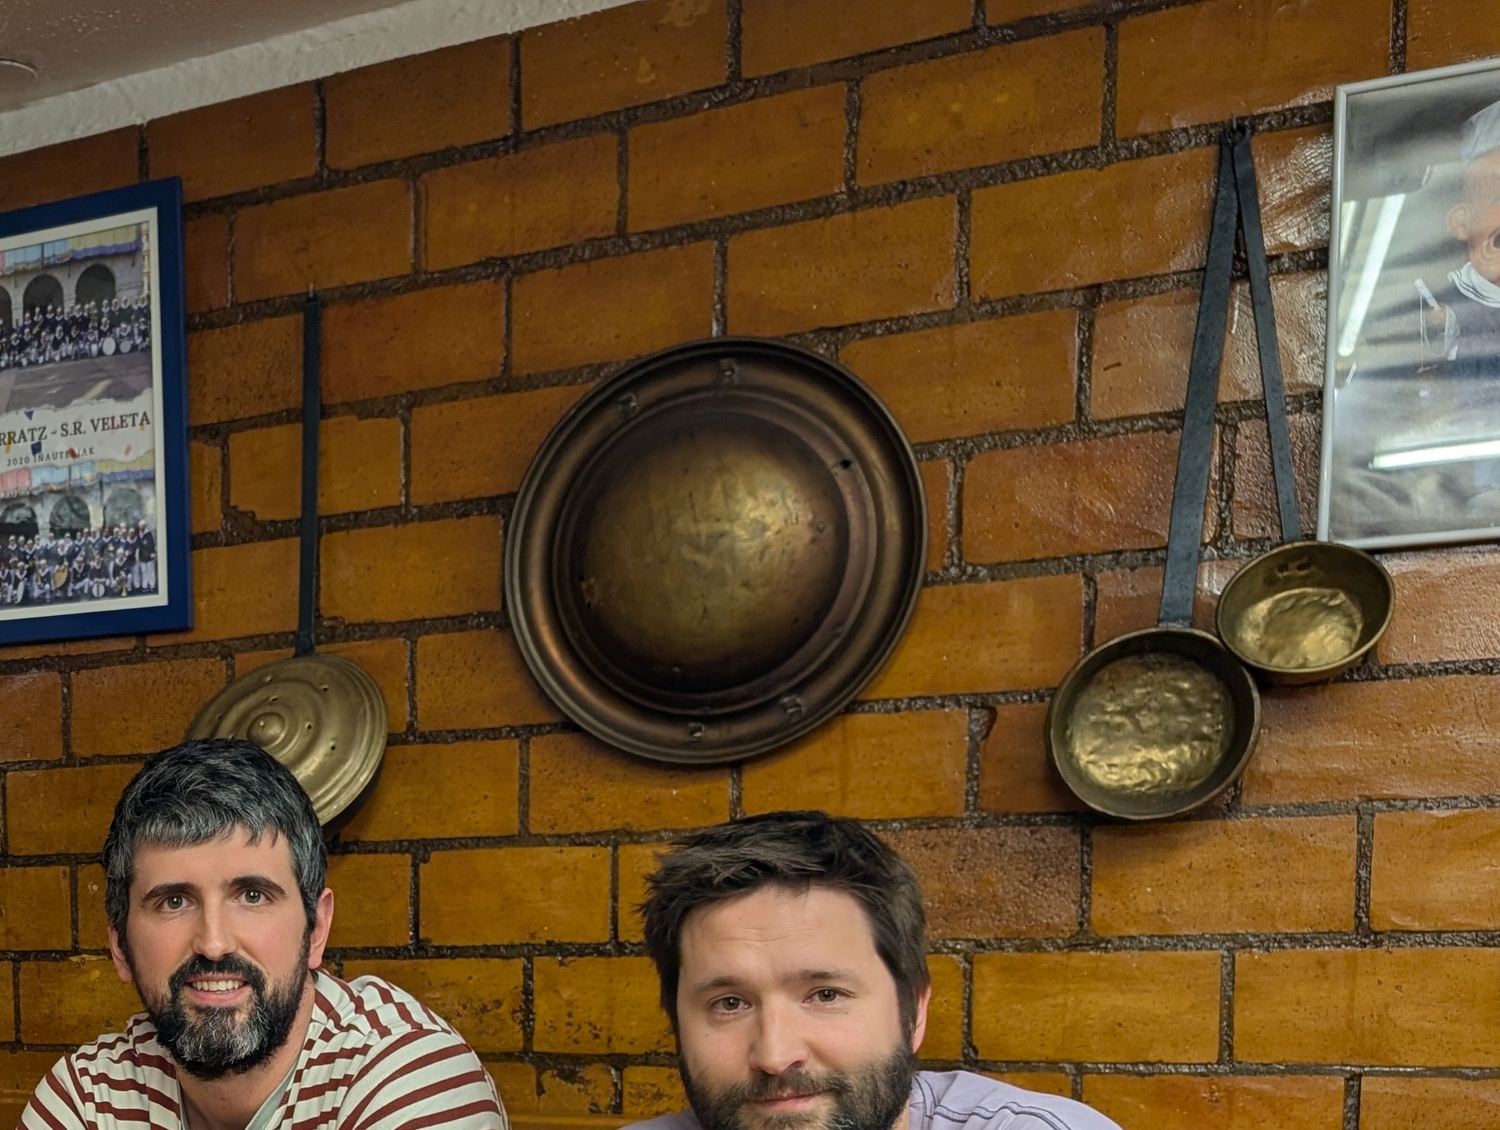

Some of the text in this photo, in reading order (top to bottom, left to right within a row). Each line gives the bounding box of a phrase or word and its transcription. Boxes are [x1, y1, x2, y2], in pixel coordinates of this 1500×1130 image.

[59, 421, 87, 437] S.R.
[90, 411, 151, 434] VELETA
[7, 456, 30, 467] 2020
